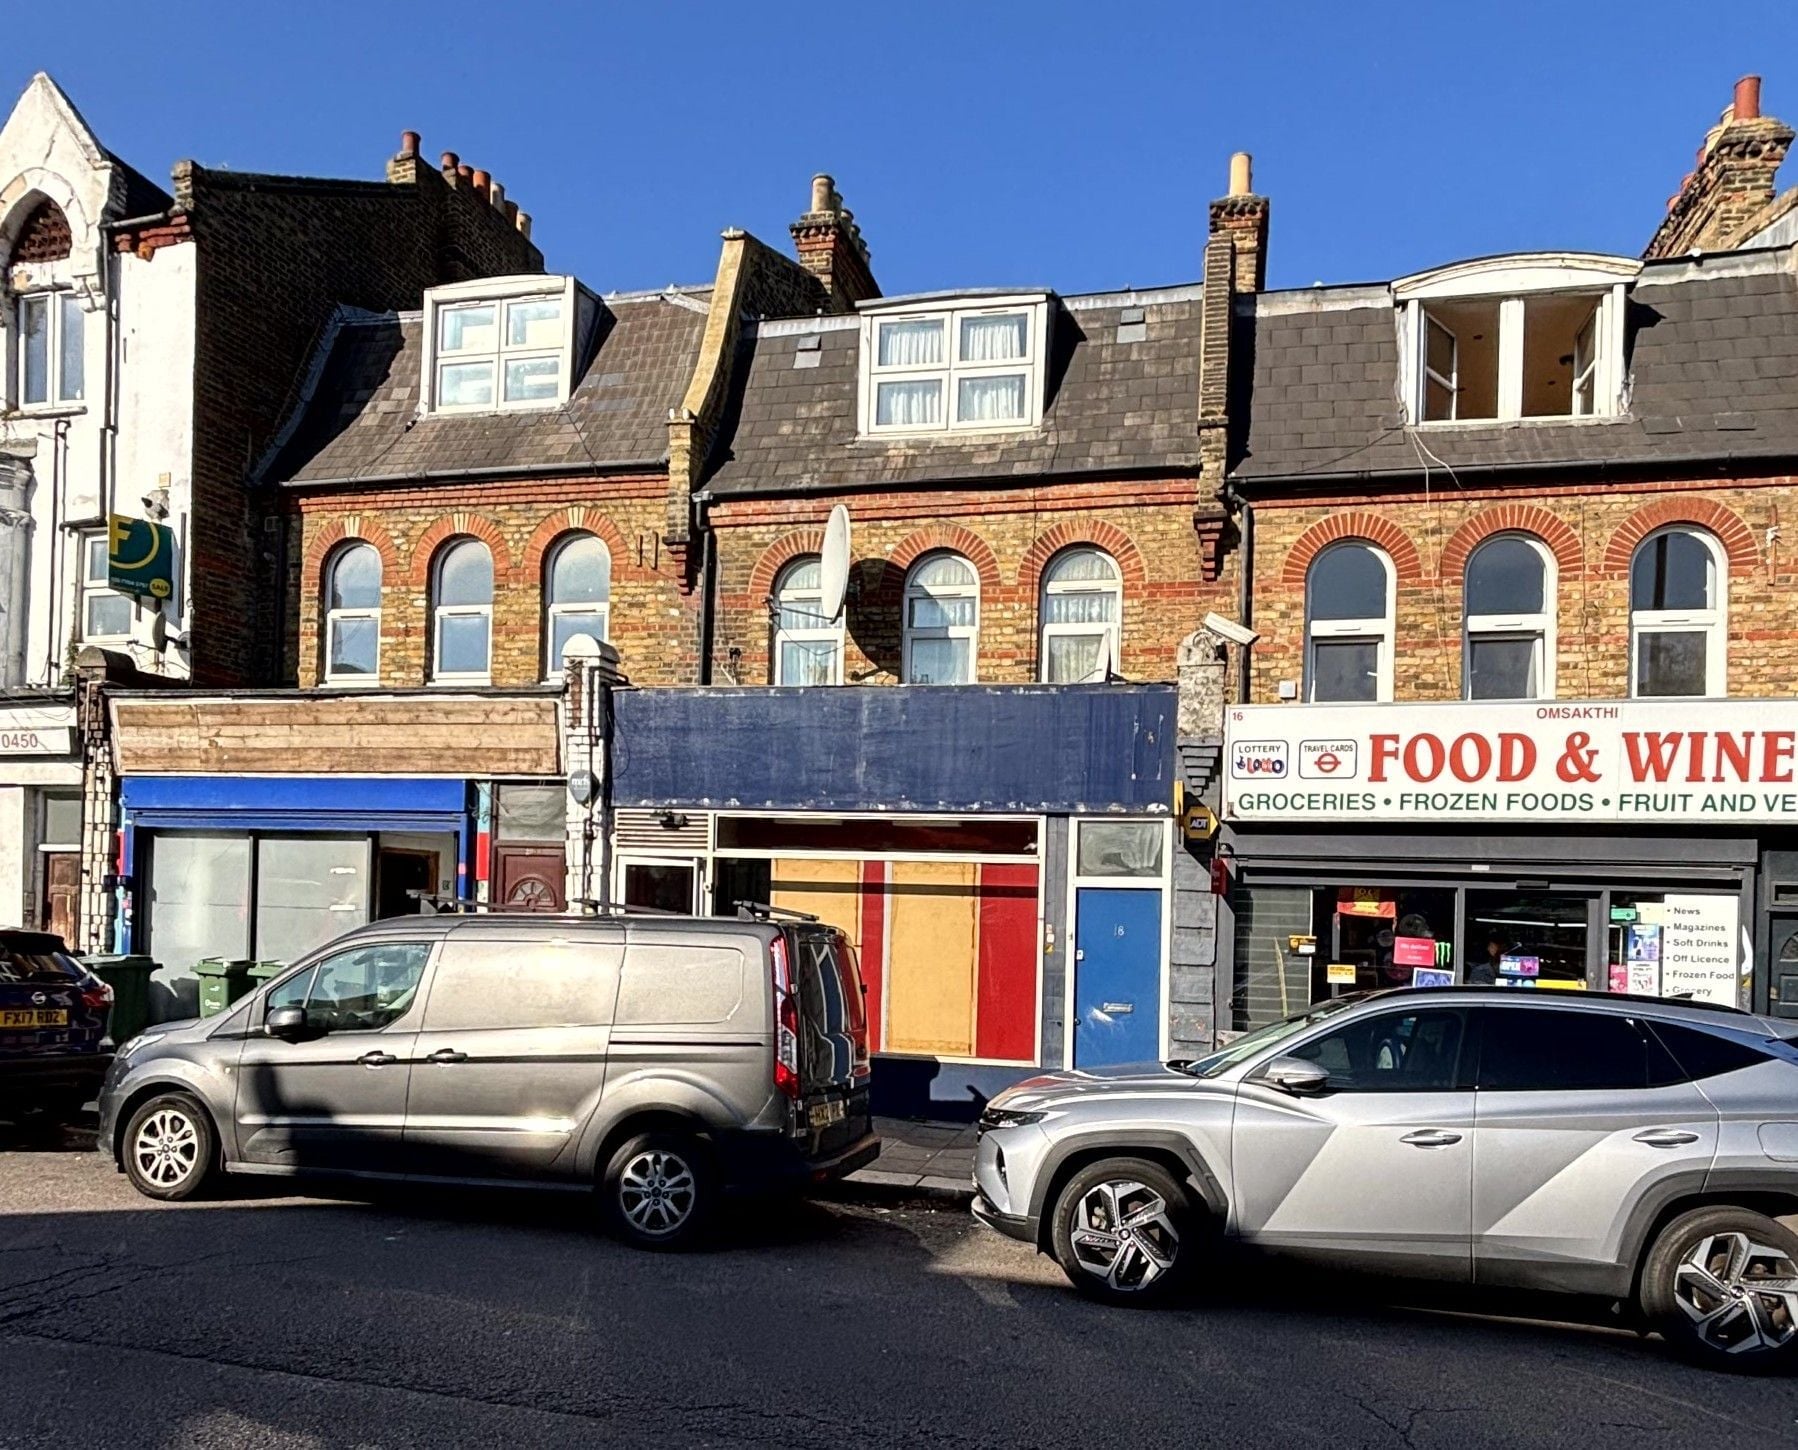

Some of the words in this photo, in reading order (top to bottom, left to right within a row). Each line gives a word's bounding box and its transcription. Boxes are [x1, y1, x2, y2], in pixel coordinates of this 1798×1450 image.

[1233, 712, 1243, 721] 16
[1536, 707, 1619, 719] OMSAKTHI
[1, 733, 38, 748] 0450
[1239, 745, 1281, 753] LOTTERY
[1304, 745, 1328, 753] TRAVEL
[1330, 744, 1353, 752] CARDS
[1367, 732, 1537, 783] FOOD
[1555, 731, 1602, 783] &
[1621, 731, 1796, 783] WINE
[1238, 792, 1376, 811] GROCERIES
[1399, 793, 1497, 811] FROZEN
[1506, 793, 1594, 811] FOODS
[1618, 793, 1693, 812] FRUIT
[1700, 793, 1756, 812] AND
[1763, 793, 1797, 812] VE
[1191, 819, 1207, 829] ADT
[1673, 906, 1700, 915] News
[1673, 922, 1726, 932] Magazines
[1673, 938, 1693, 947] Soft
[1696, 939, 1729, 948] Drinks
[1672, 954, 1688, 963] Off
[1690, 955, 1730, 964] Licence
[1672, 970, 1707, 979] Frozen
[1709, 971, 1735, 980] Food
